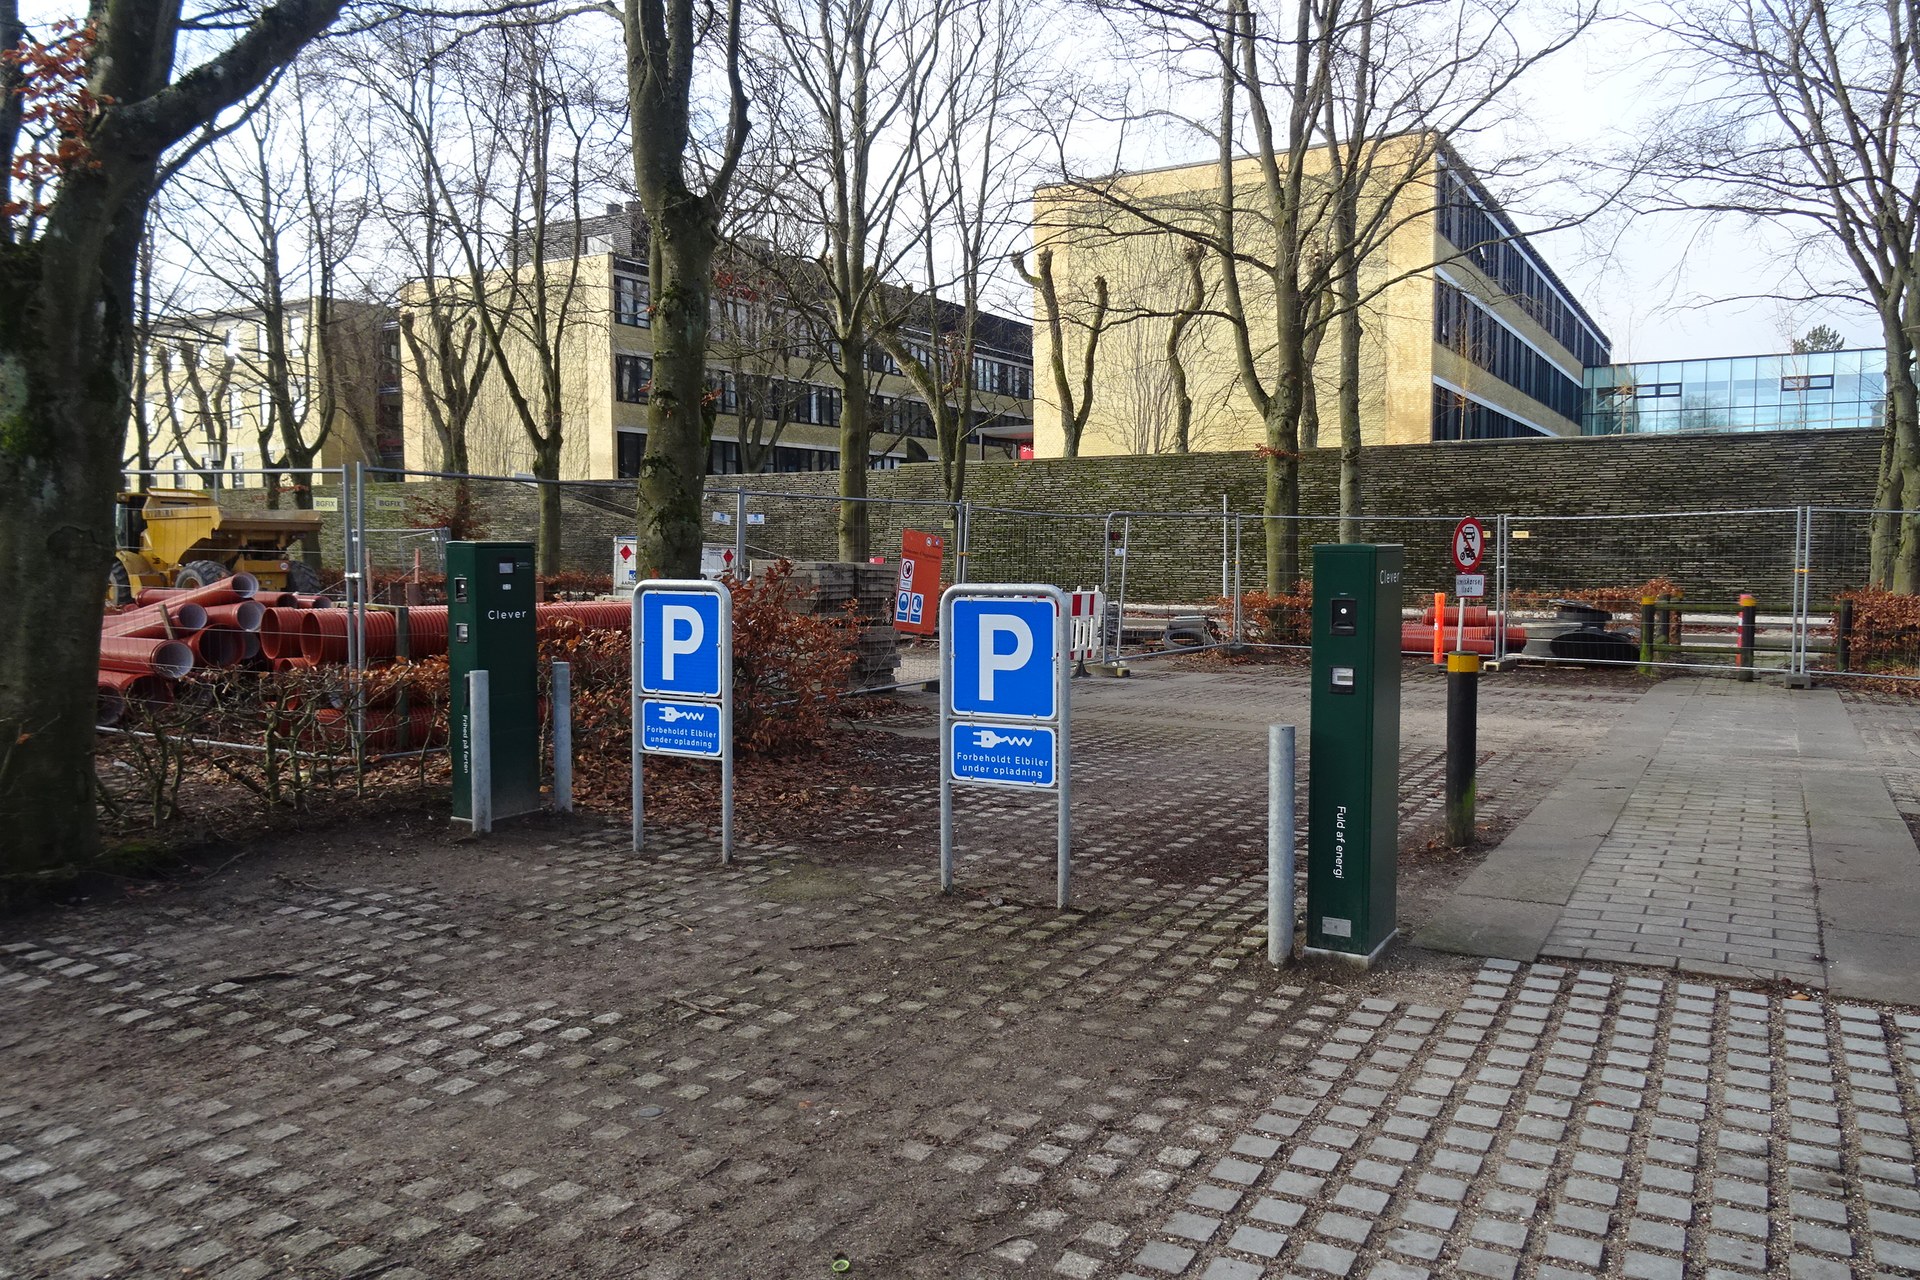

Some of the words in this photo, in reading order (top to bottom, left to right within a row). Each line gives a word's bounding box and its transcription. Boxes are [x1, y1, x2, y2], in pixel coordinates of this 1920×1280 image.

[1380, 569, 1400, 584] Clever
[487, 610, 527, 620] Clever
[662, 605, 704, 681] P
[978, 613, 1034, 701] P
[646, 725, 688, 736] Forbeholdt
[690, 729, 717, 738] Elbiler
[650, 736, 672, 744] under
[674, 738, 712, 749] opladning
[957, 752, 1011, 764] Forbeholdt
[1015, 756, 1049, 767] Elbiler
[962, 764, 990, 773] under
[993, 766, 1043, 779] opladning
[1336, 805, 1347, 829] Fuld
[1336, 831, 1346, 843] af
[1332, 845, 1345, 879] energi
